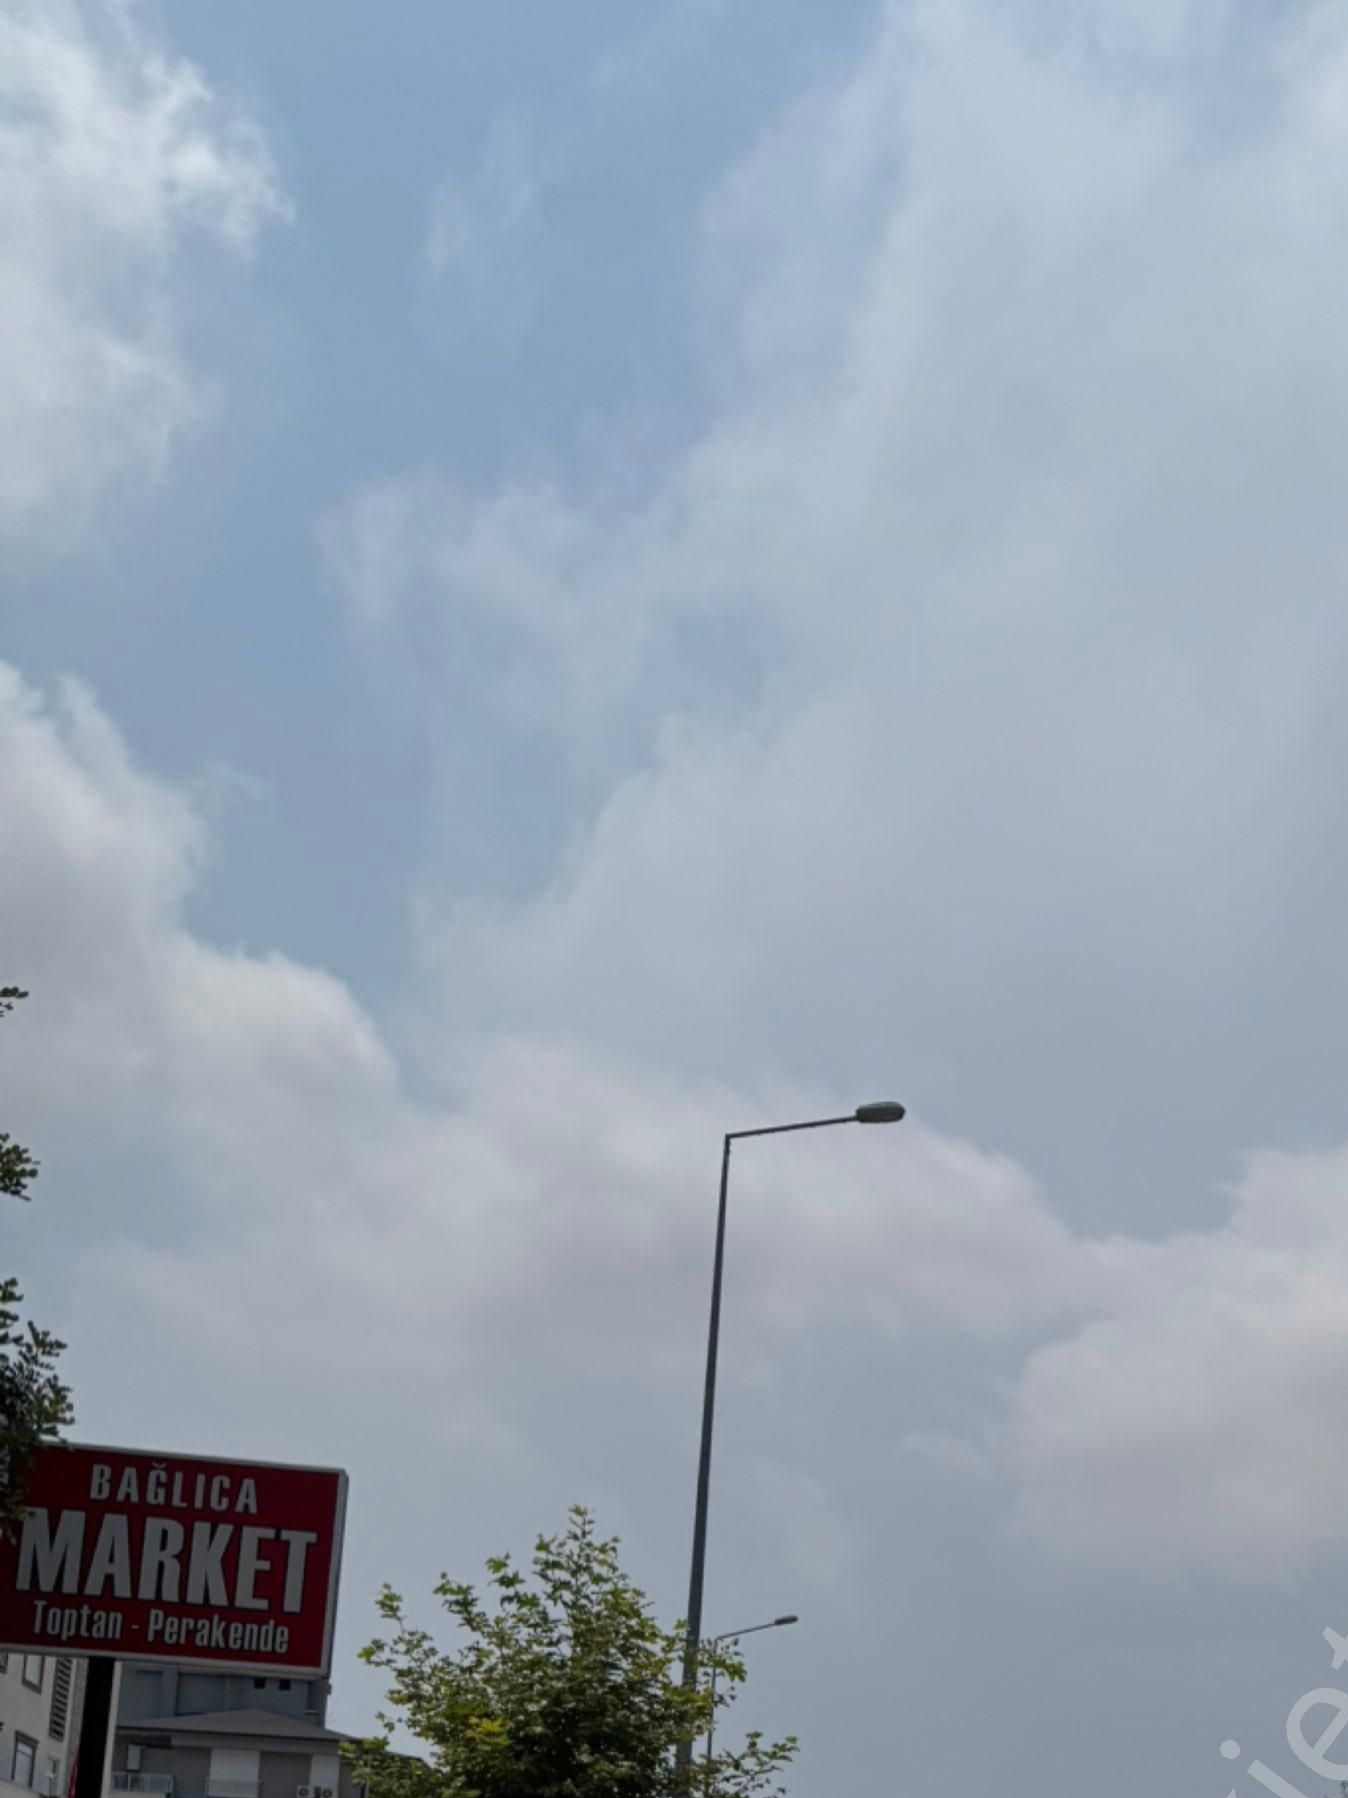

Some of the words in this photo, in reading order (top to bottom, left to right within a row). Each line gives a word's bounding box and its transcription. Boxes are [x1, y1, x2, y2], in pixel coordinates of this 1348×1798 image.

[90, 1461, 259, 1515] BAĞLICA
[15, 1507, 318, 1614] MARKET
[33, 1600, 123, 1641] Toptan
[147, 1608, 289, 1655] Perakende
